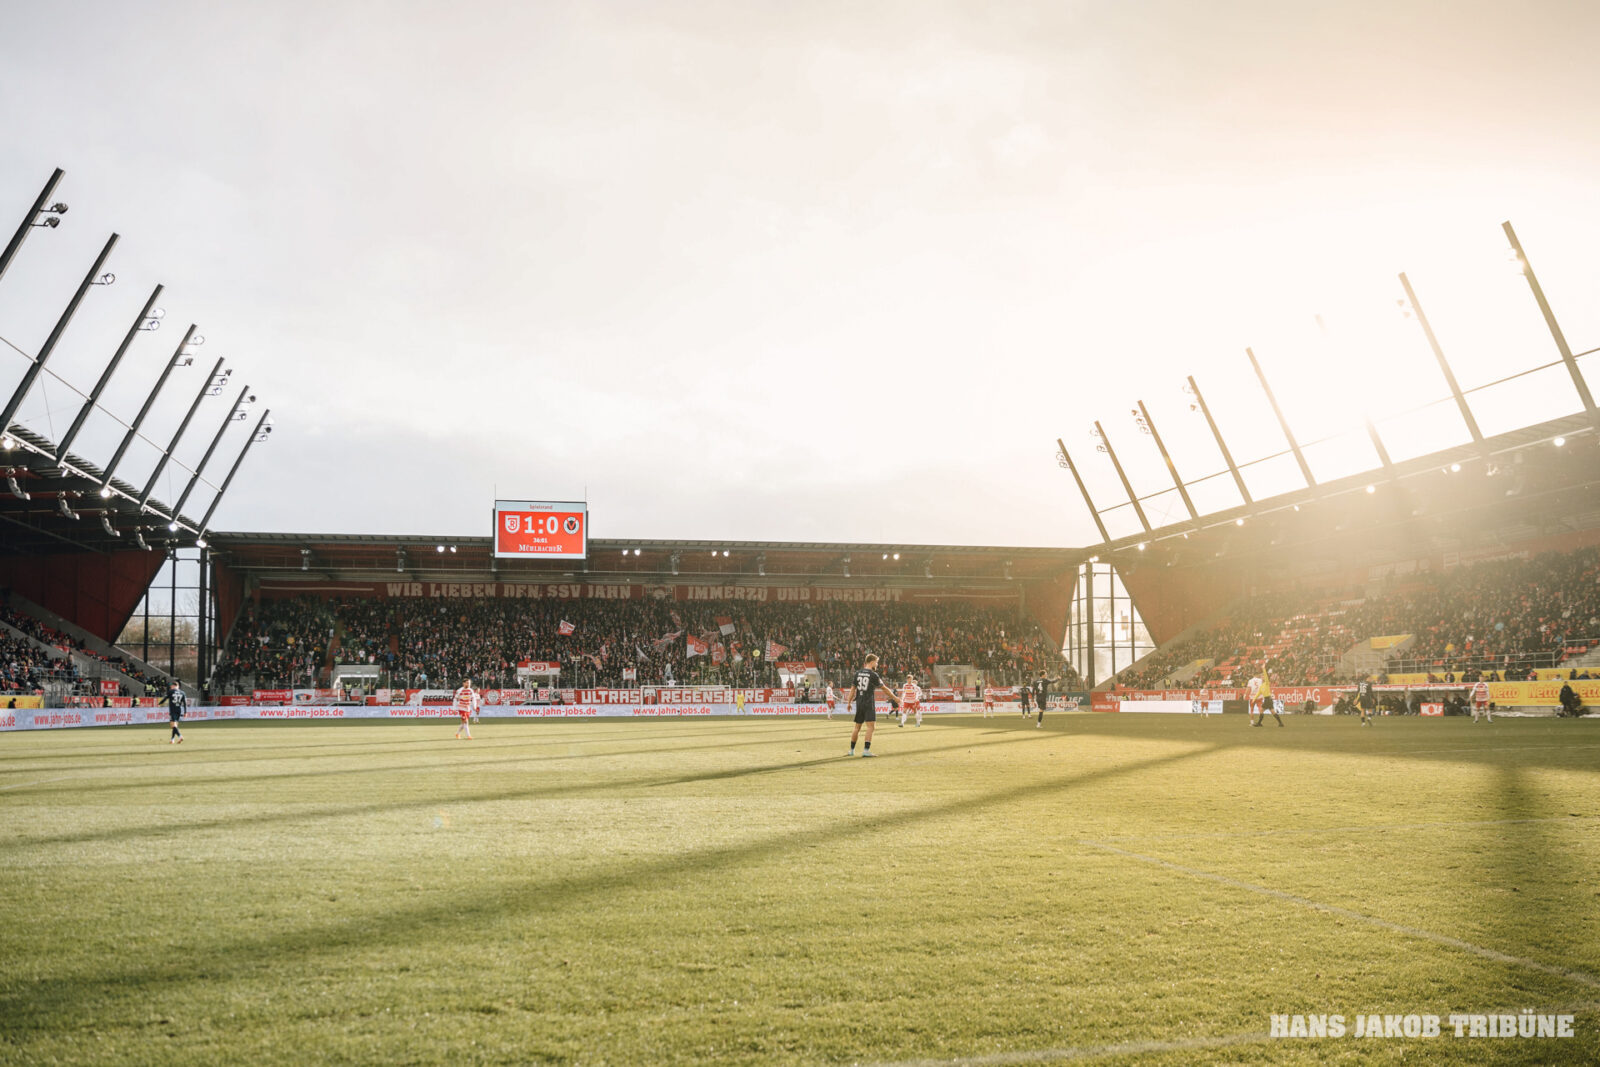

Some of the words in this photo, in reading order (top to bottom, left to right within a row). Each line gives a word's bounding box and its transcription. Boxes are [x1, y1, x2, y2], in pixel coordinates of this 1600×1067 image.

[524, 515, 559, 535] 1:0
[387, 582, 423, 597] WIR
[430, 583, 497, 598] LIEBEN
[547, 584, 582, 598] SSV
[587, 585, 631, 599] JAHN
[687, 586, 769, 601] IMMERZU
[777, 587, 810, 600] UND
[856, 676, 870, 692] 39
[581, 690, 640, 704] ULTRAS
[661, 689, 765, 703] REGENSBURG
[1305, 688, 1321, 703] AG
[1490, 686, 1520, 698] Netto
[1528, 685, 1560, 698] Netto
[172, 694, 183, 703] 37
[260, 708, 344, 718] www.jahn-jobs.de
[517, 707, 597, 717] www.jahn-jobs.de
[633, 706, 711, 716] www.jahn-jobs.de
[752, 705, 828, 715] www.jahn-jobs.de
[1420, 704, 1443, 715] WOLF
[34, 712, 81, 728] www.jahn-jobs.de
